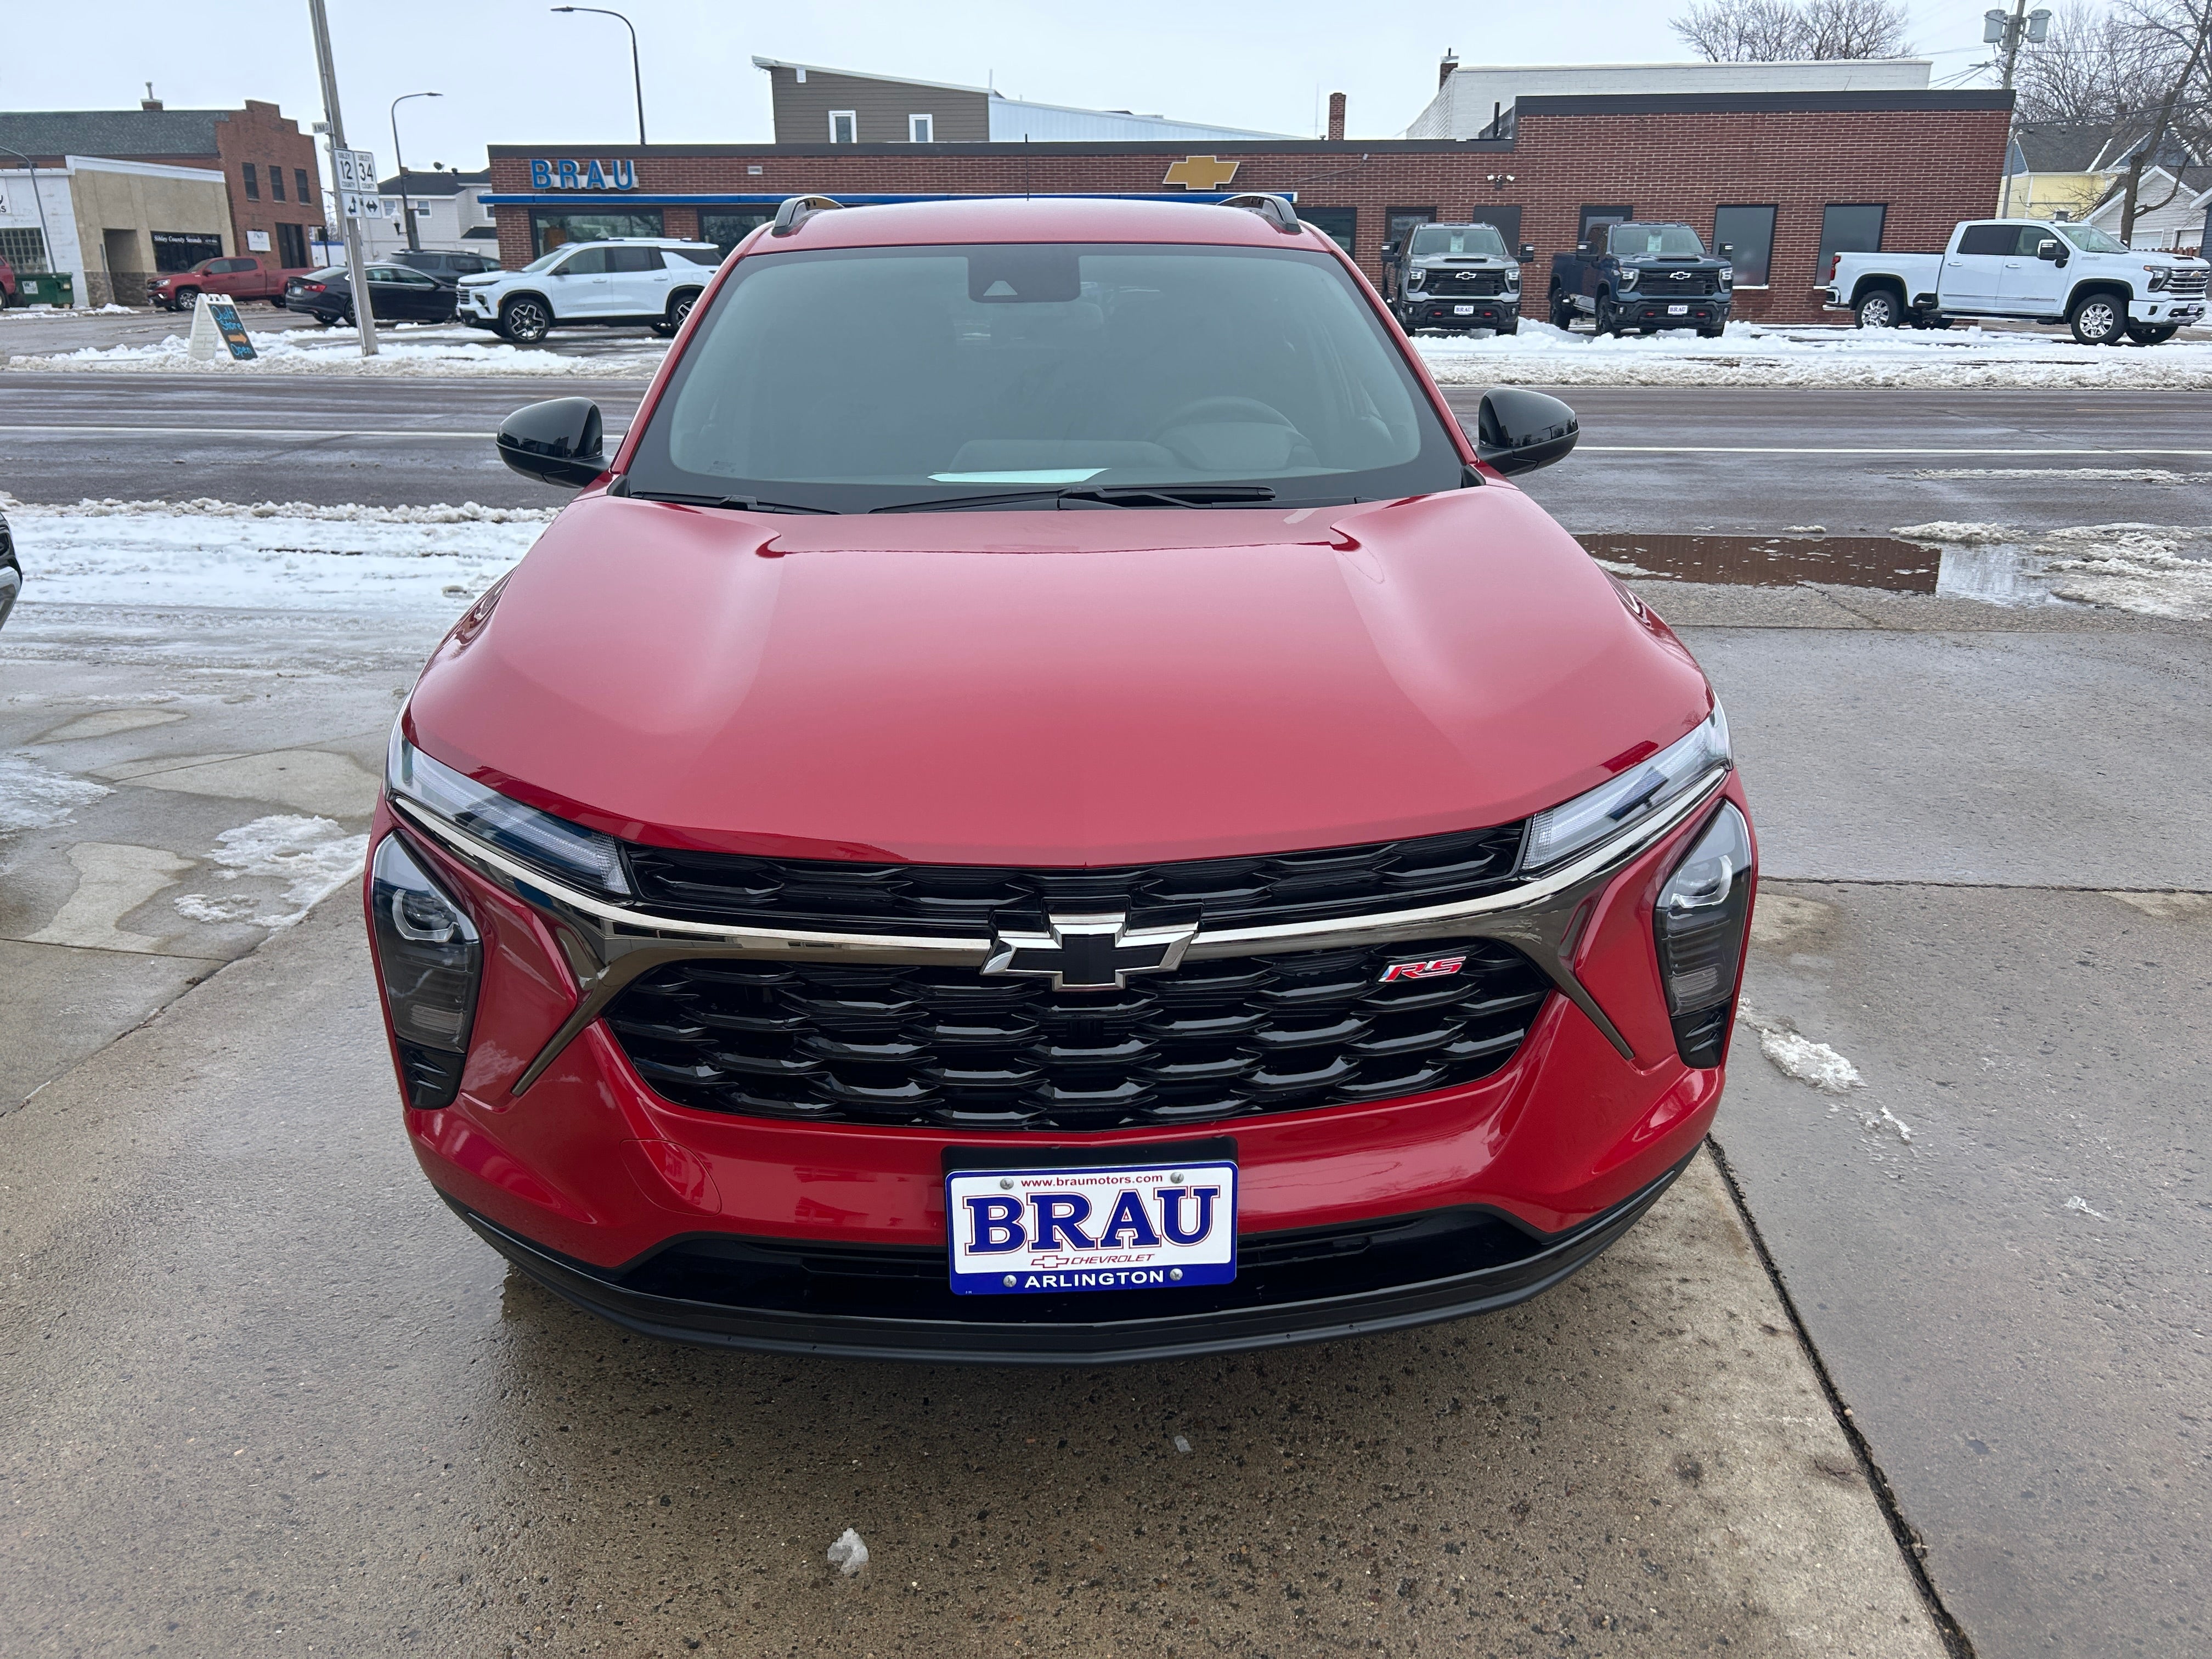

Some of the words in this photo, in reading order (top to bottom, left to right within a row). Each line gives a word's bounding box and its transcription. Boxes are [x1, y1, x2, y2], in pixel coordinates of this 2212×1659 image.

[340, 161, 353, 179] 12
[359, 162, 374, 182] 34
[531, 159, 635, 190] BRAU
[168, 235, 185, 244] County
[211, 306, 235, 321] Quilt
[219, 319, 244, 331] Store
[230, 343, 253, 358] Open
[1378, 956, 1467, 983] RS
[1020, 1173, 1163, 1187] www.braumotors.com
[962, 1184, 1221, 1256] BRAU
[1070, 1254, 1155, 1265] CHEVROLET
[1024, 1269, 1164, 1289] ARLINGTON
